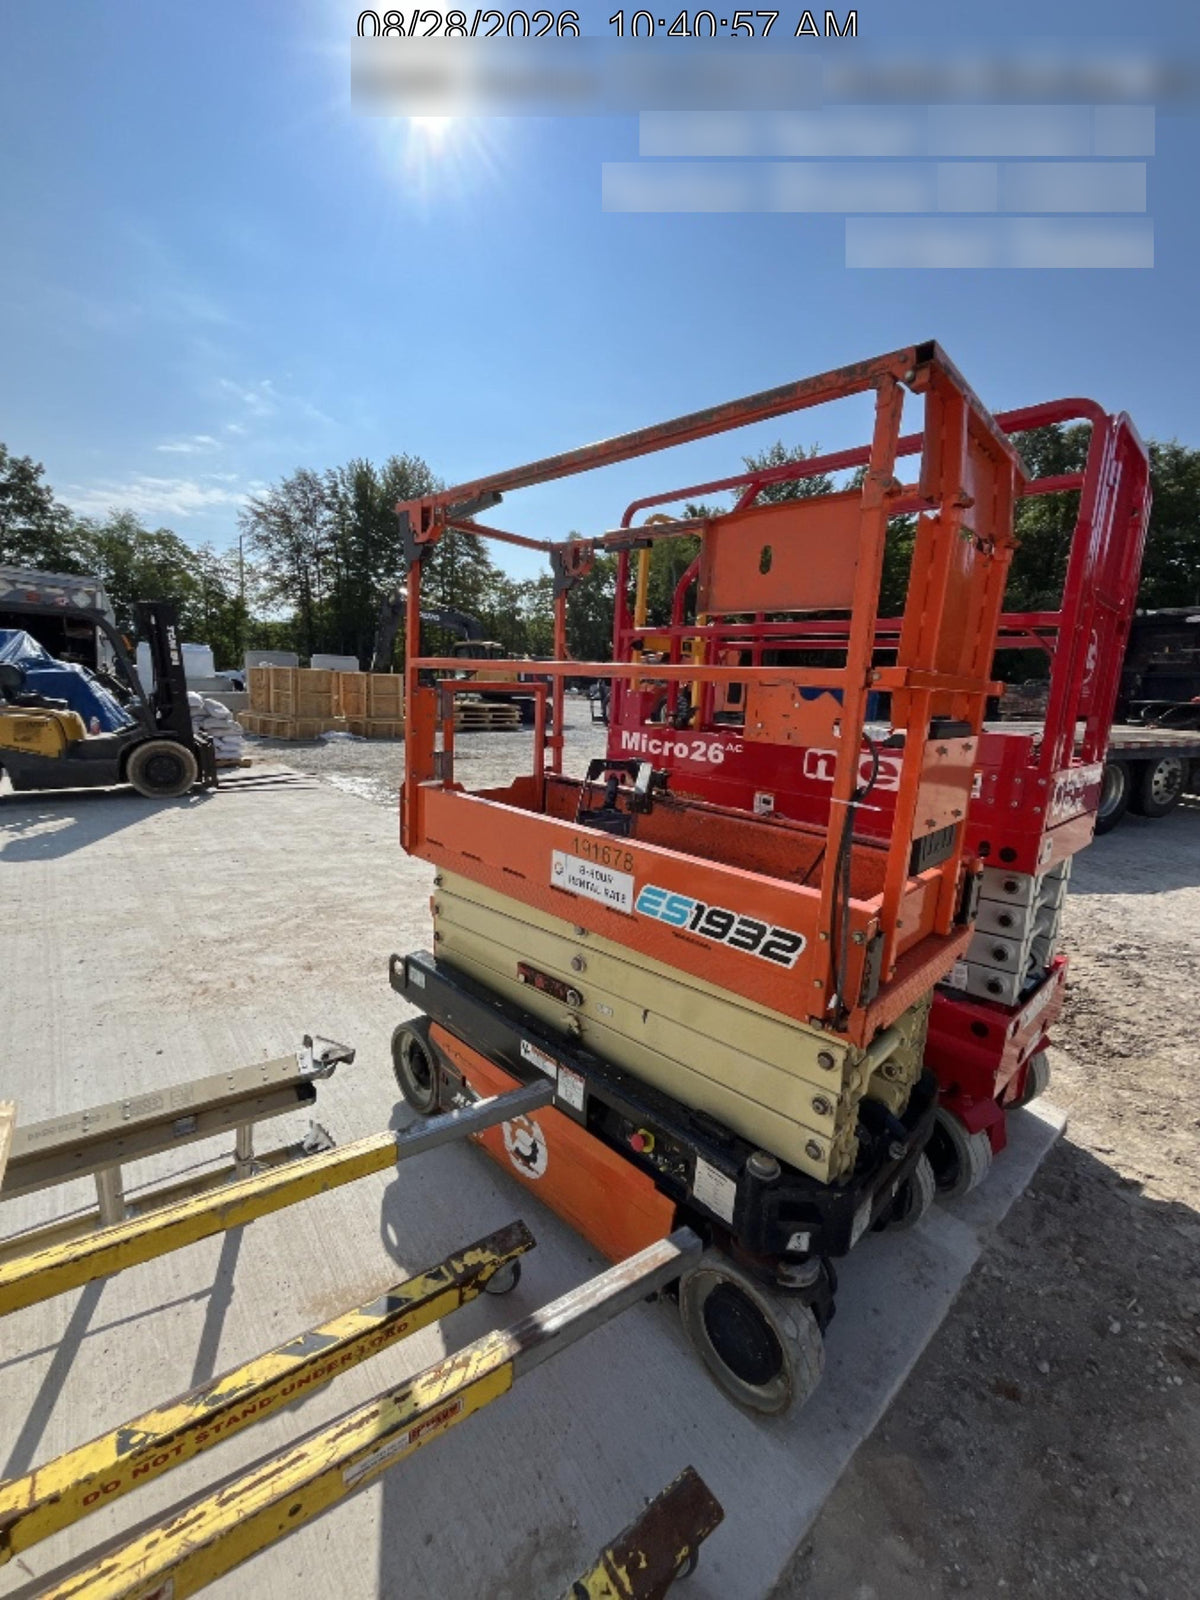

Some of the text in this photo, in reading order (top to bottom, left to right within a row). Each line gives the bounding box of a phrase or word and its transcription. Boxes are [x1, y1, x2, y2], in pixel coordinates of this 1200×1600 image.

[621, 730, 725, 764] Micro26
[573, 836, 634, 872] 191678
[636, 885, 806, 967] ES1932
[82, 1479, 122, 1507] DO
[131, 1442, 185, 1480] NOT
[195, 1394, 275, 1445] STAND
[280, 1351, 353, 1397] UNDER
